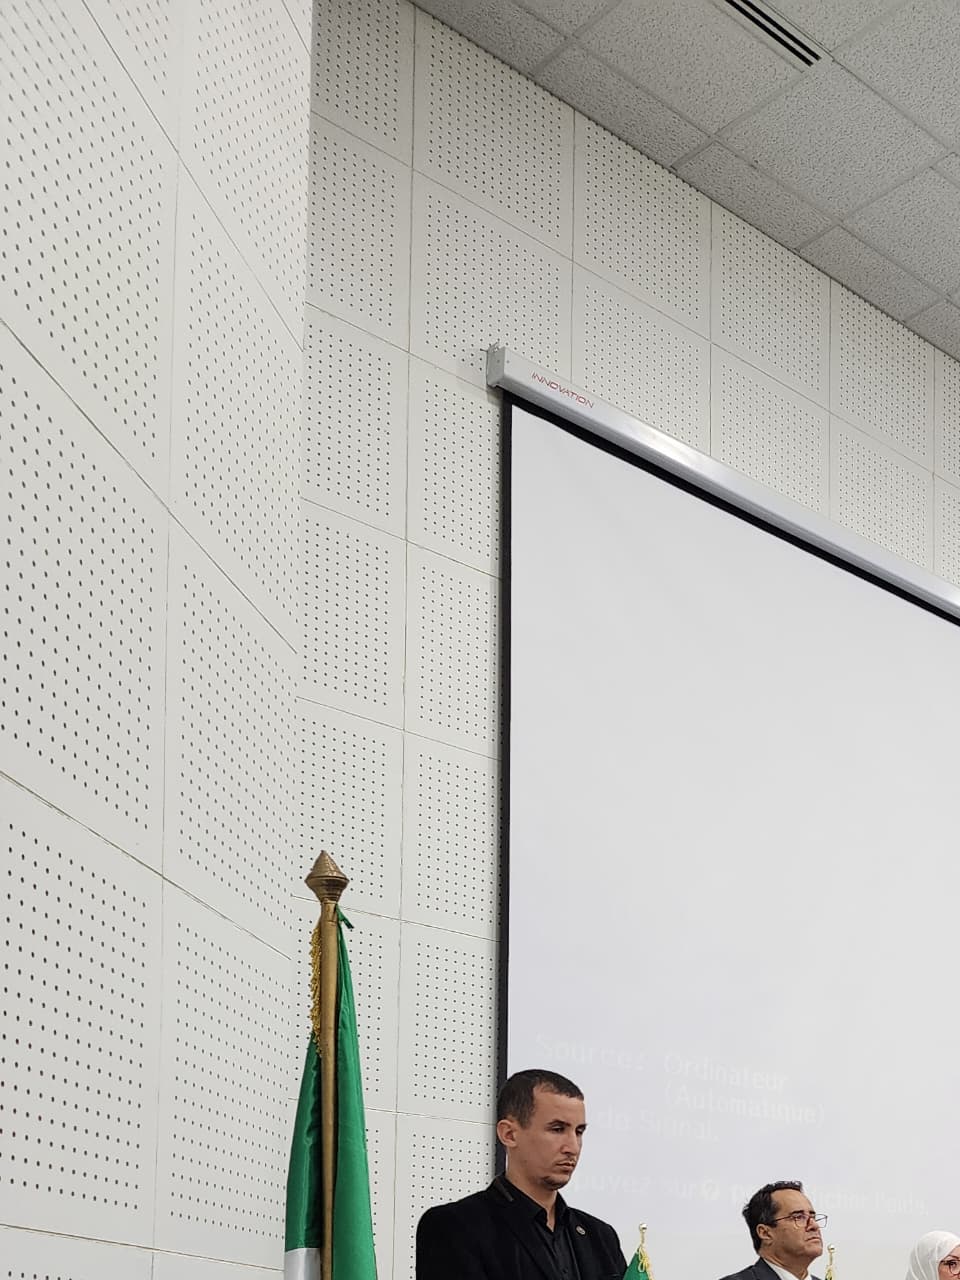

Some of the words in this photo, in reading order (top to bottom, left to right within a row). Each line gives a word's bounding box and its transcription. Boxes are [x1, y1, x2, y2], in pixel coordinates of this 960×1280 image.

[531, 371, 594, 409] INNOVATION
[664, 1049, 790, 1096] Ordinateur
[665, 1079, 825, 1129] (Automatique)
